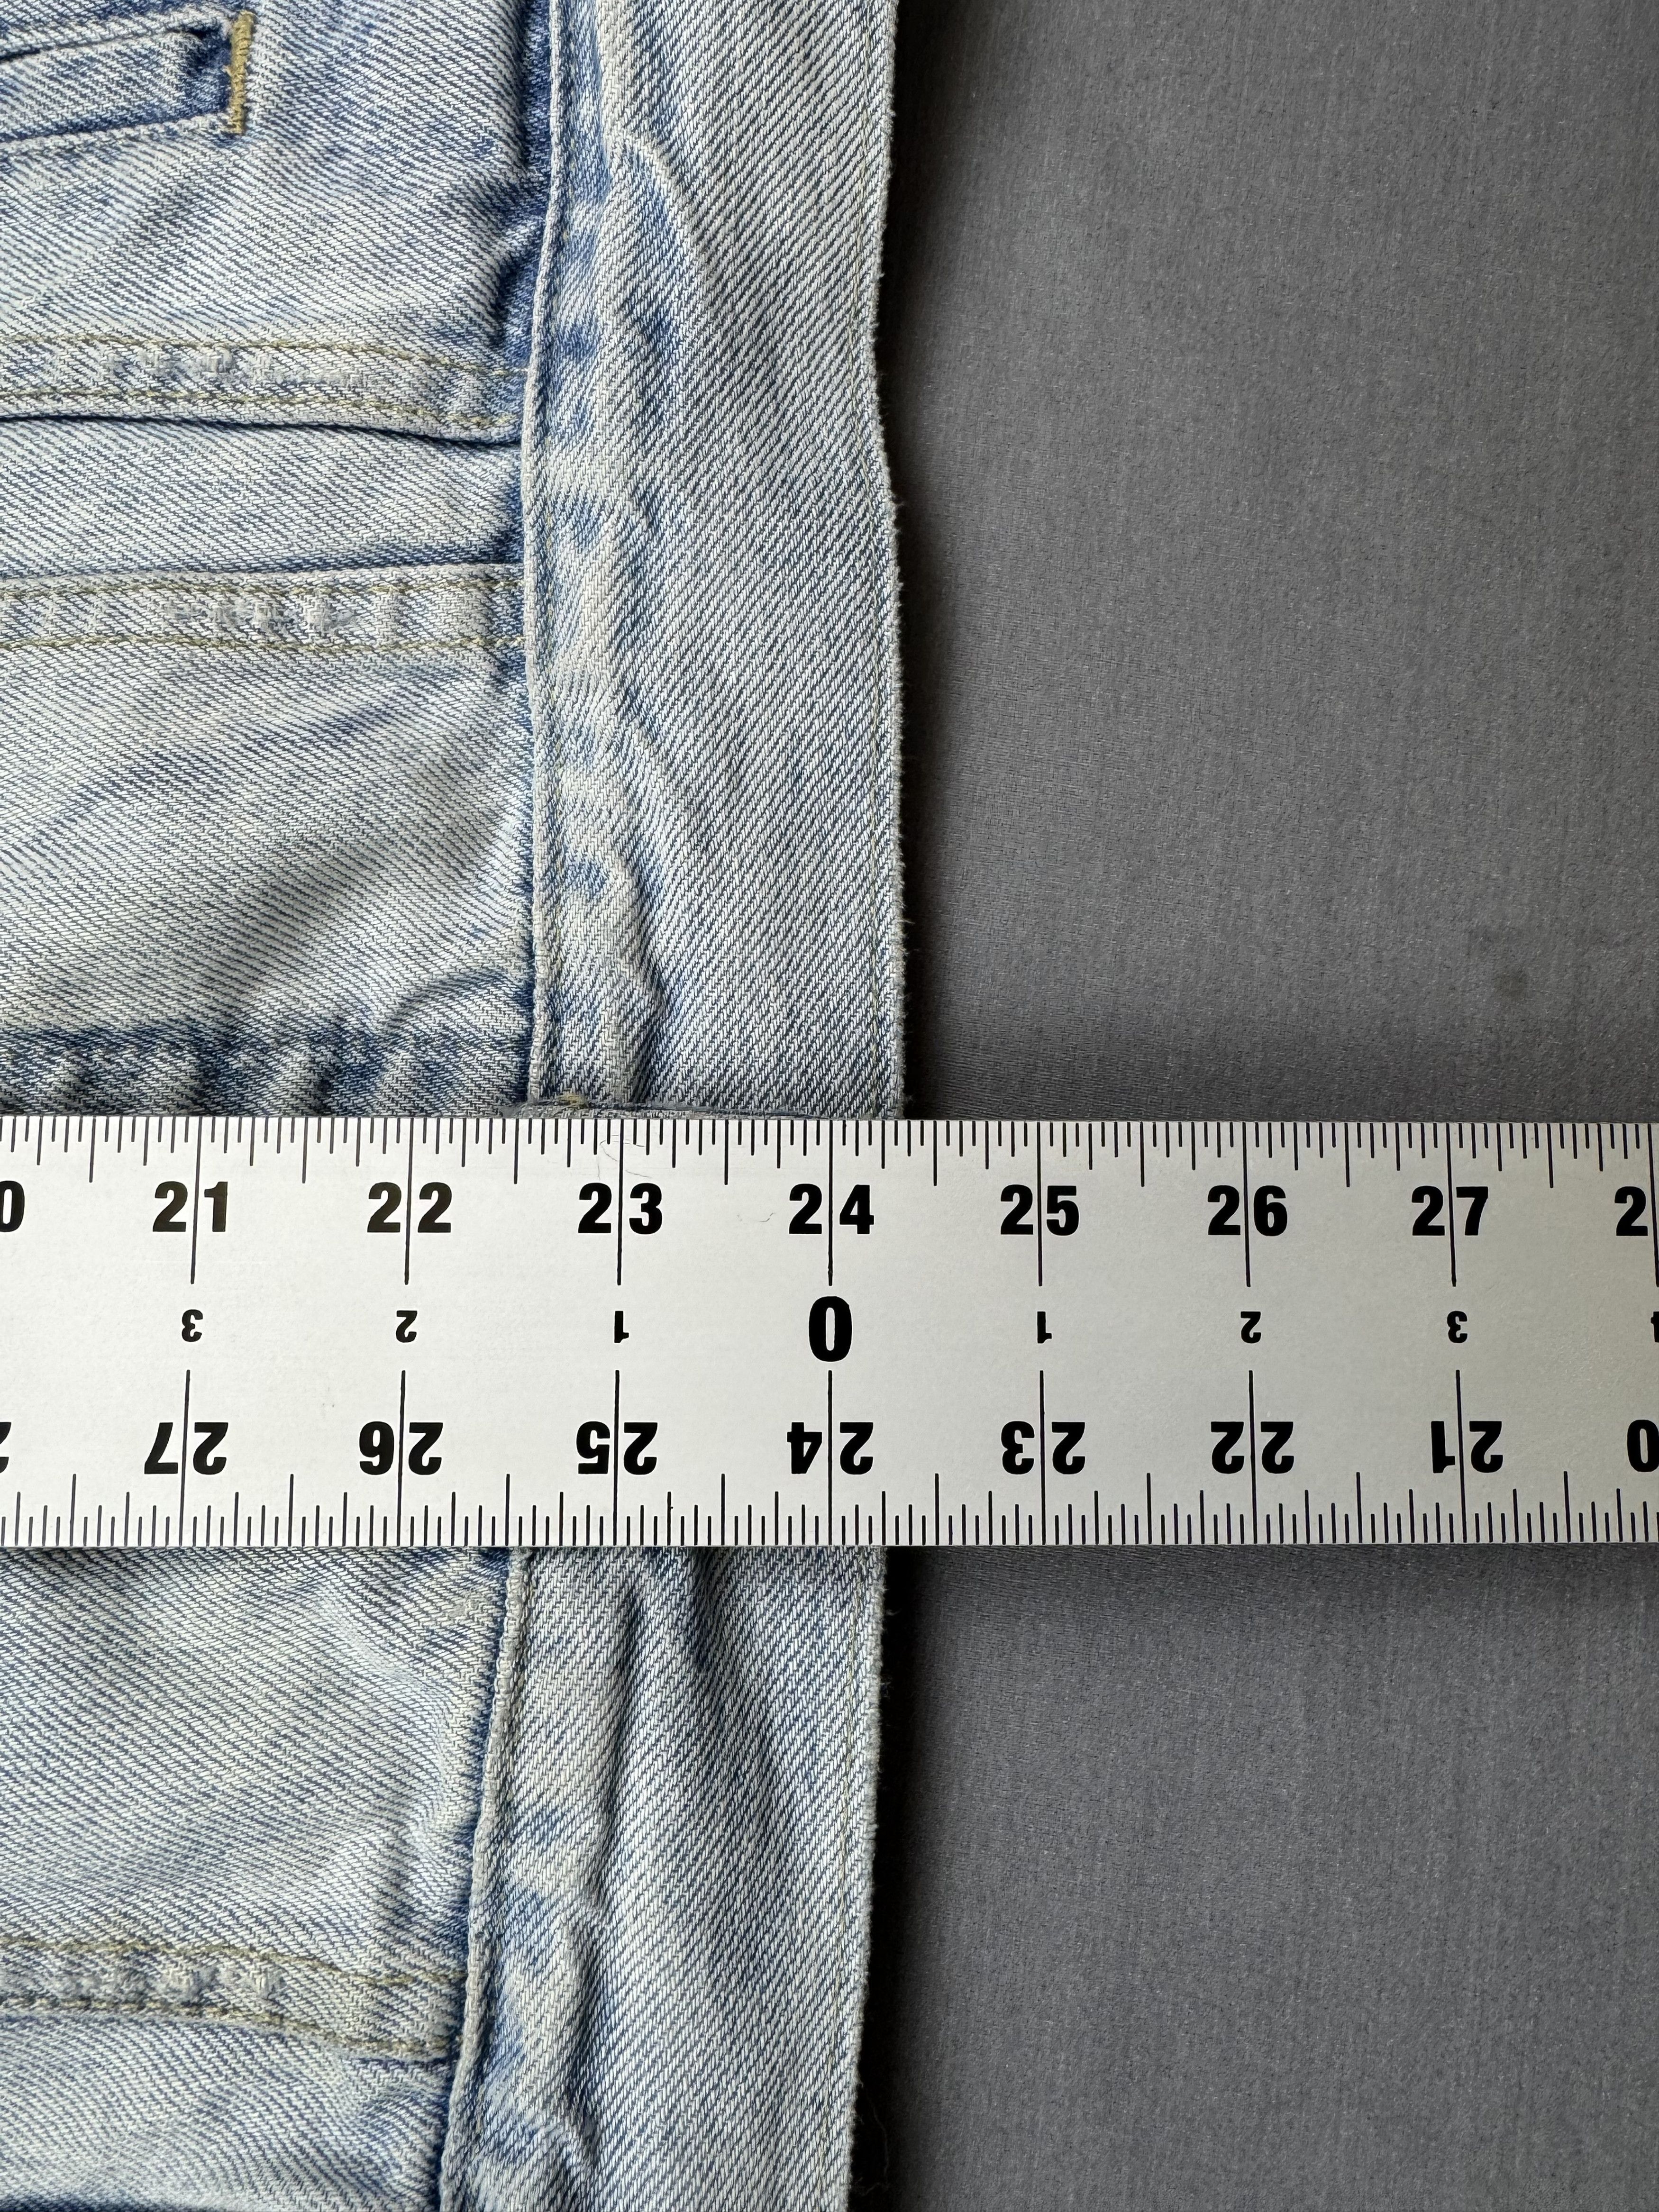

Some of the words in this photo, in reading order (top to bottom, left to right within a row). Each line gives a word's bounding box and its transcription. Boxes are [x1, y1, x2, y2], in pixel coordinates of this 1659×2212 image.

[152, 1181, 228, 1232] 21
[367, 1182, 452, 1233] 22
[578, 1183, 663, 1235] 23
[789, 1183, 875, 1235] 24
[1000, 1184, 1079, 1236] 25
[1207, 1185, 1288, 1237] 26
[1411, 1185, 1489, 1236] 27
[182, 1309, 203, 1342] 3
[396, 1310, 418, 1343] 2
[614, 1311, 629, 1343] 1
[808, 1296, 852, 1362] 0
[1037, 1311, 1052, 1344] 1
[1240, 1311, 1262, 1344] 2
[1447, 1310, 1468, 1344] 3
[144, 1422, 228, 1475] 27
[359, 1421, 443, 1475] 26
[576, 1421, 658, 1475] 25
[787, 1422, 874, 1475] 24
[1001, 1420, 1085, 1475] 23
[1211, 1421, 1294, 1475] 22
[1431, 1420, 1504, 1474] 21
